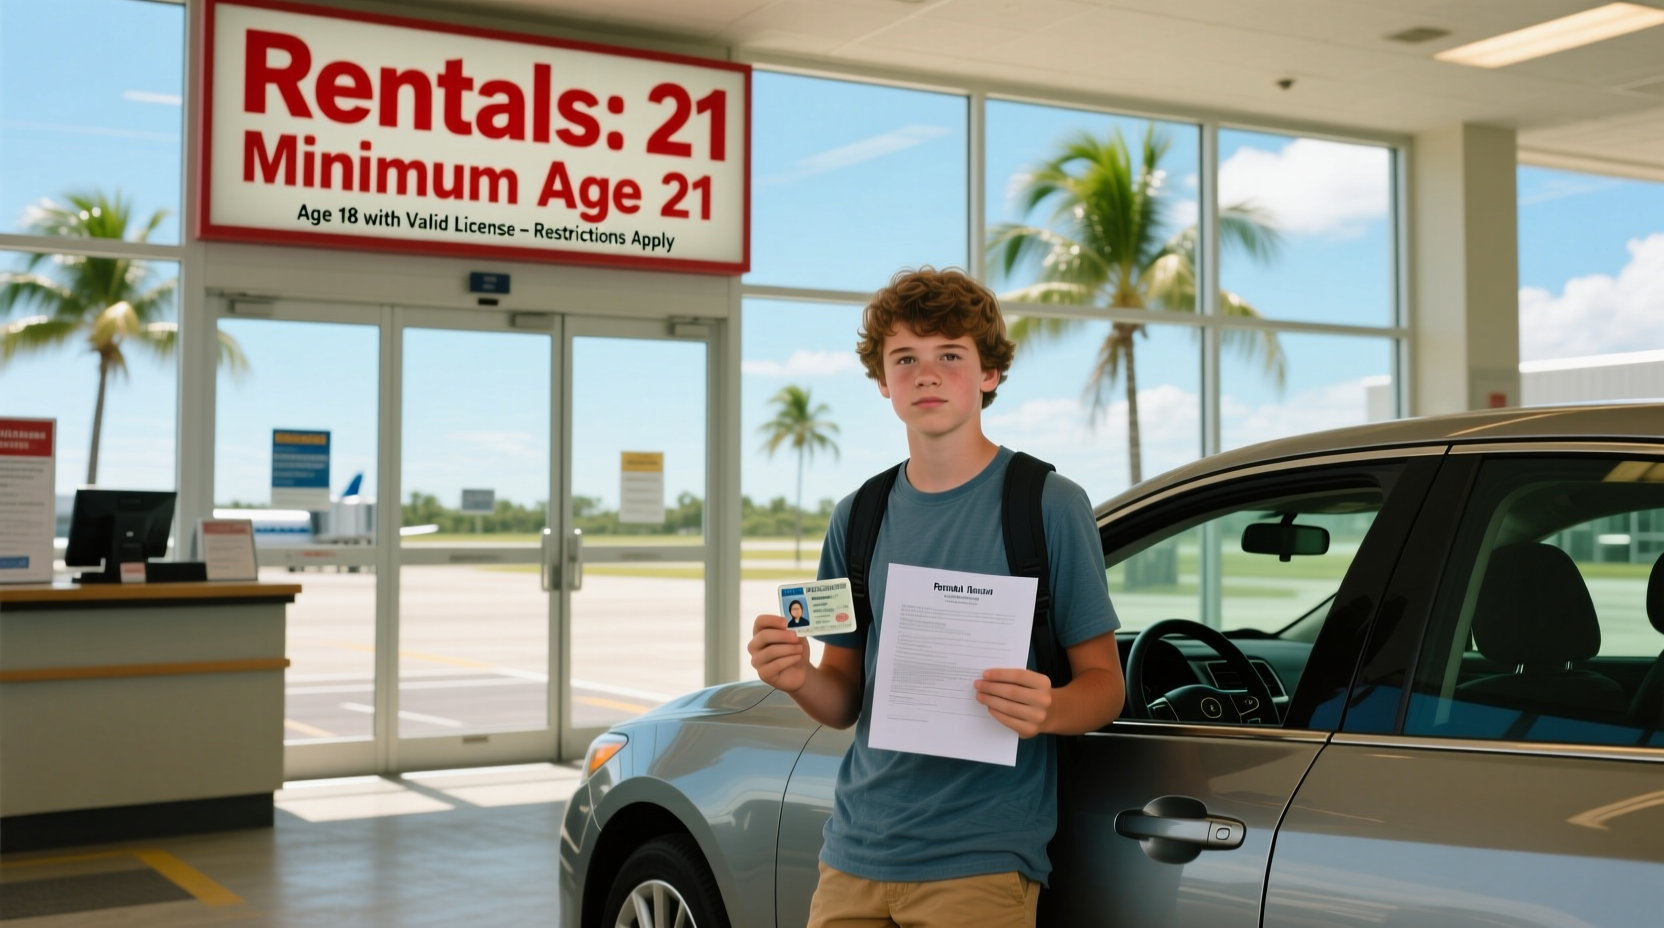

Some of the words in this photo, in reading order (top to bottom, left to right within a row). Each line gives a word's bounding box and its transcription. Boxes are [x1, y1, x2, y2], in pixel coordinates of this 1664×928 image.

[243, 28, 625, 152] Rentals:
[645, 82, 728, 162] 21
[242, 130, 519, 205] Minimum
[537, 160, 643, 224] Age
[660, 171, 712, 221] 21
[297, 203, 333, 226] Age
[338, 207, 359, 224] 18
[363, 208, 401, 228] with
[405, 211, 449, 232] Valid
[454, 215, 516, 237] License
[534, 222, 626, 245] Restrictions
[631, 231, 676, 253] Apply
